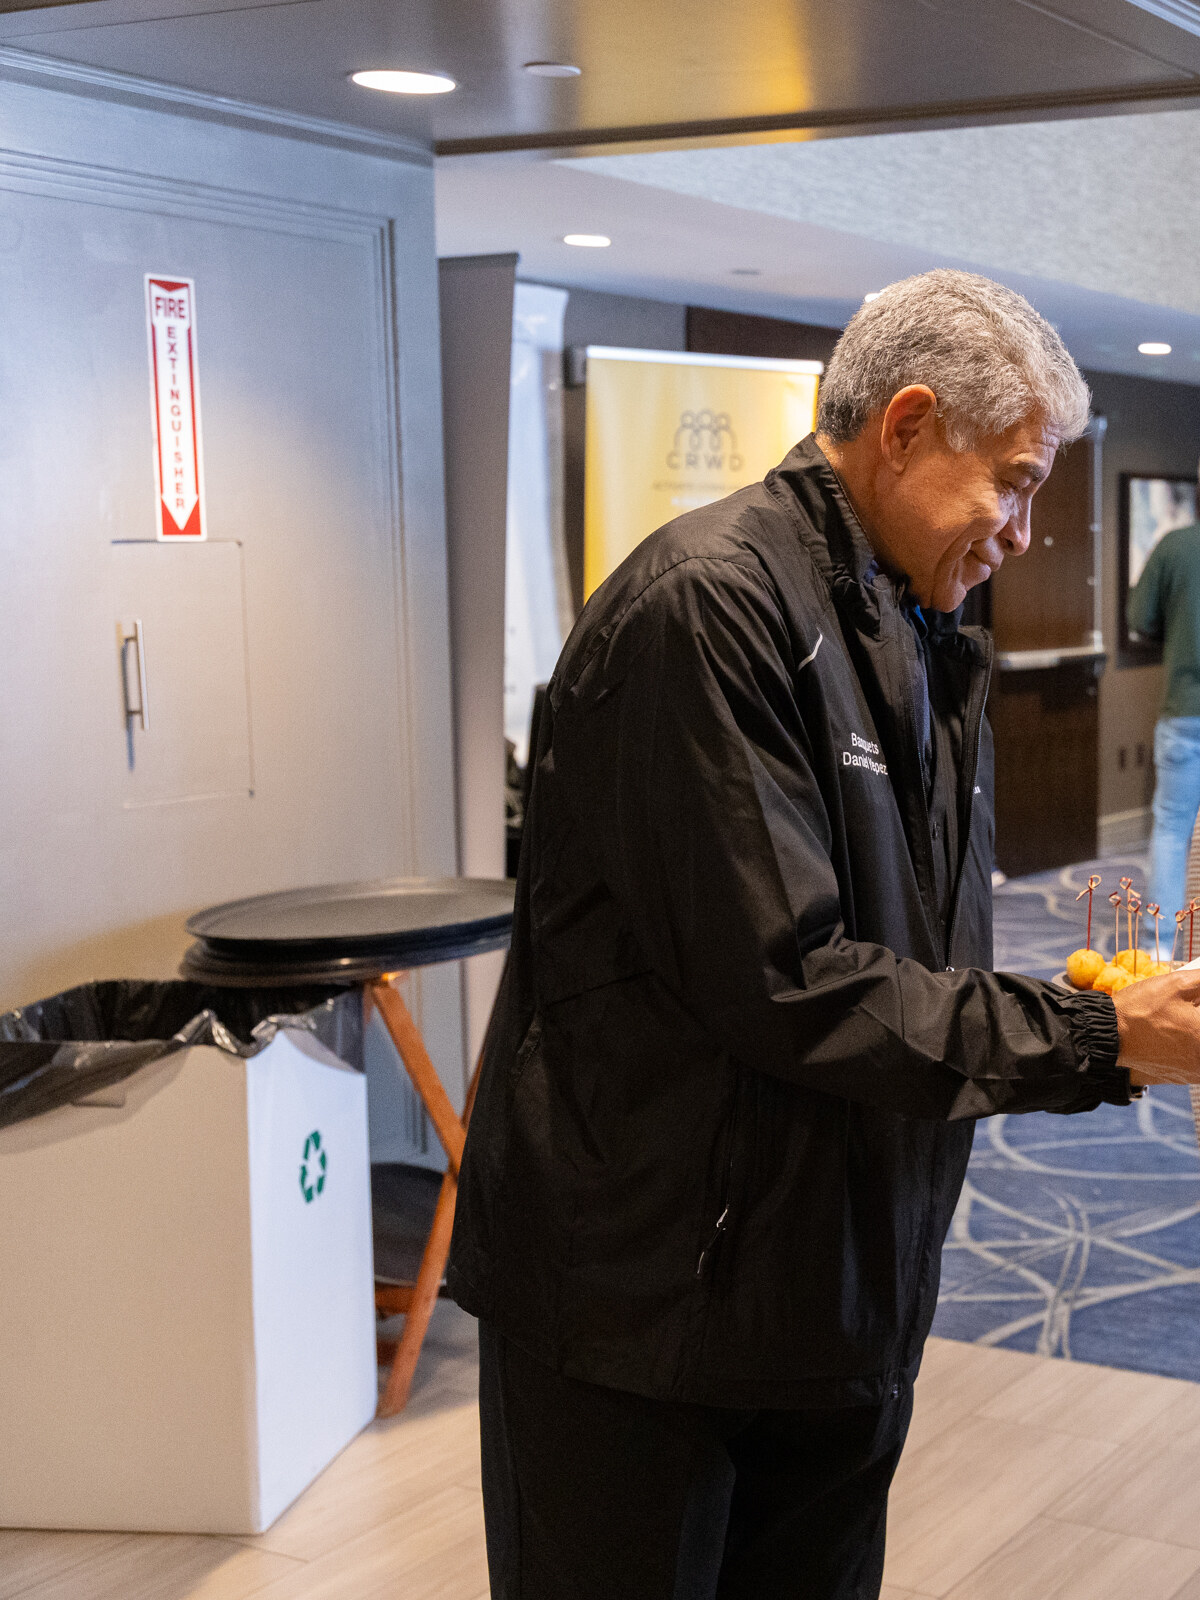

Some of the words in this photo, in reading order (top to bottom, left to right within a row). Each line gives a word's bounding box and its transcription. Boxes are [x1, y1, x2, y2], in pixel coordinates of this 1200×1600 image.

[155, 297, 185, 319] FIRE
[166, 325, 185, 509] EXTINGUISHER
[665, 450, 745, 473] CRWD
